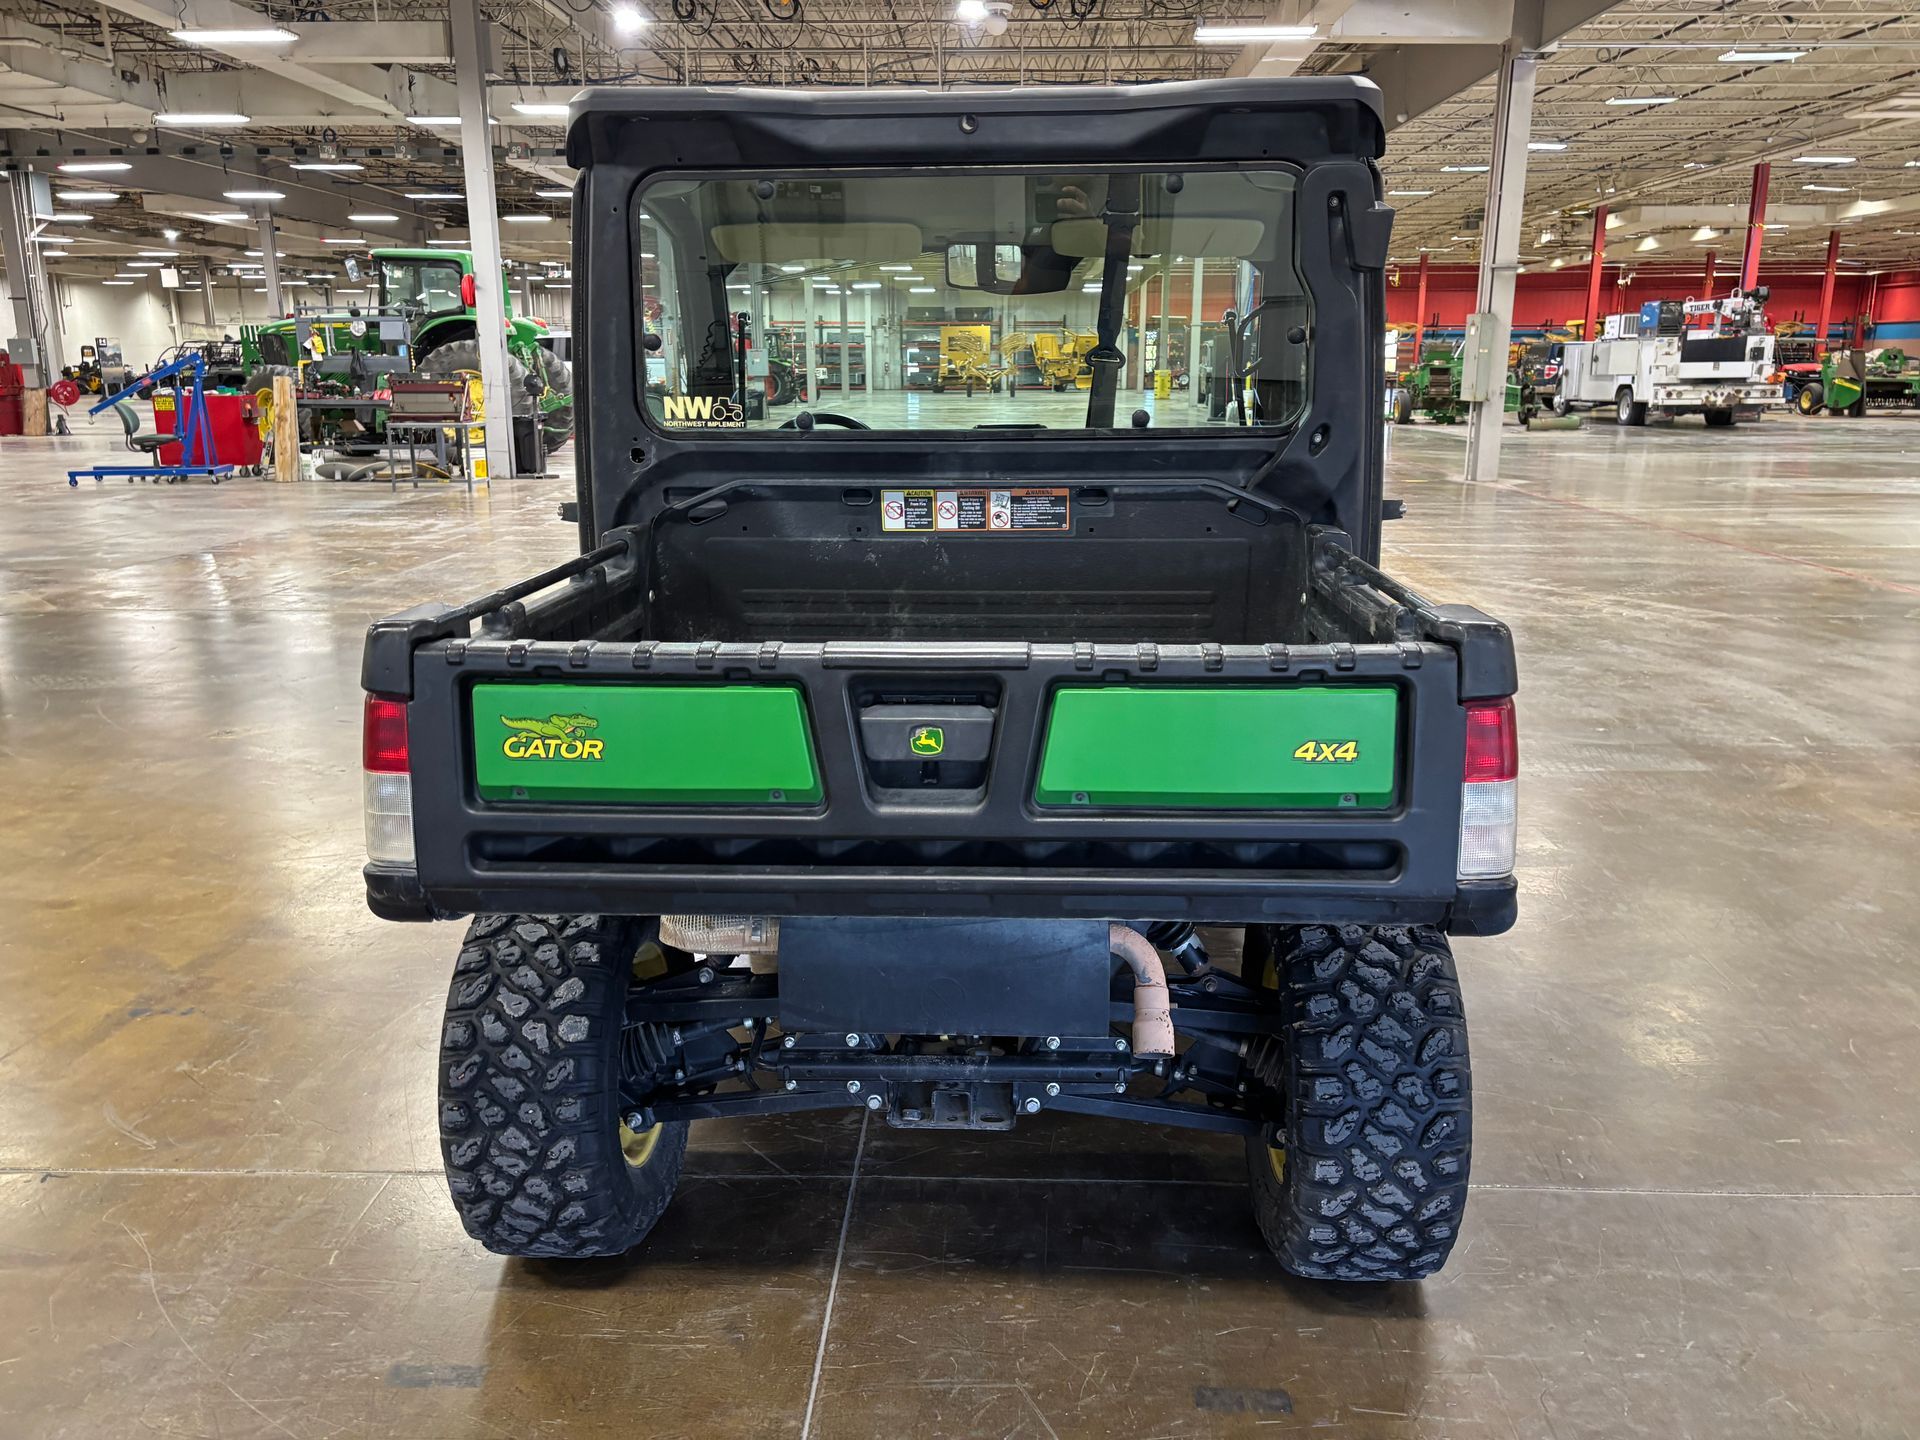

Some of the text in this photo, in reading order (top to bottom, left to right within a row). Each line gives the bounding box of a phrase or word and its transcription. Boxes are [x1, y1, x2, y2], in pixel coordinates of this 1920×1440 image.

[1689, 303, 1710, 312] TIGER
[663, 396, 713, 419] NW
[503, 736, 604, 760] GATOR
[1294, 741, 1358, 762] 4x4
